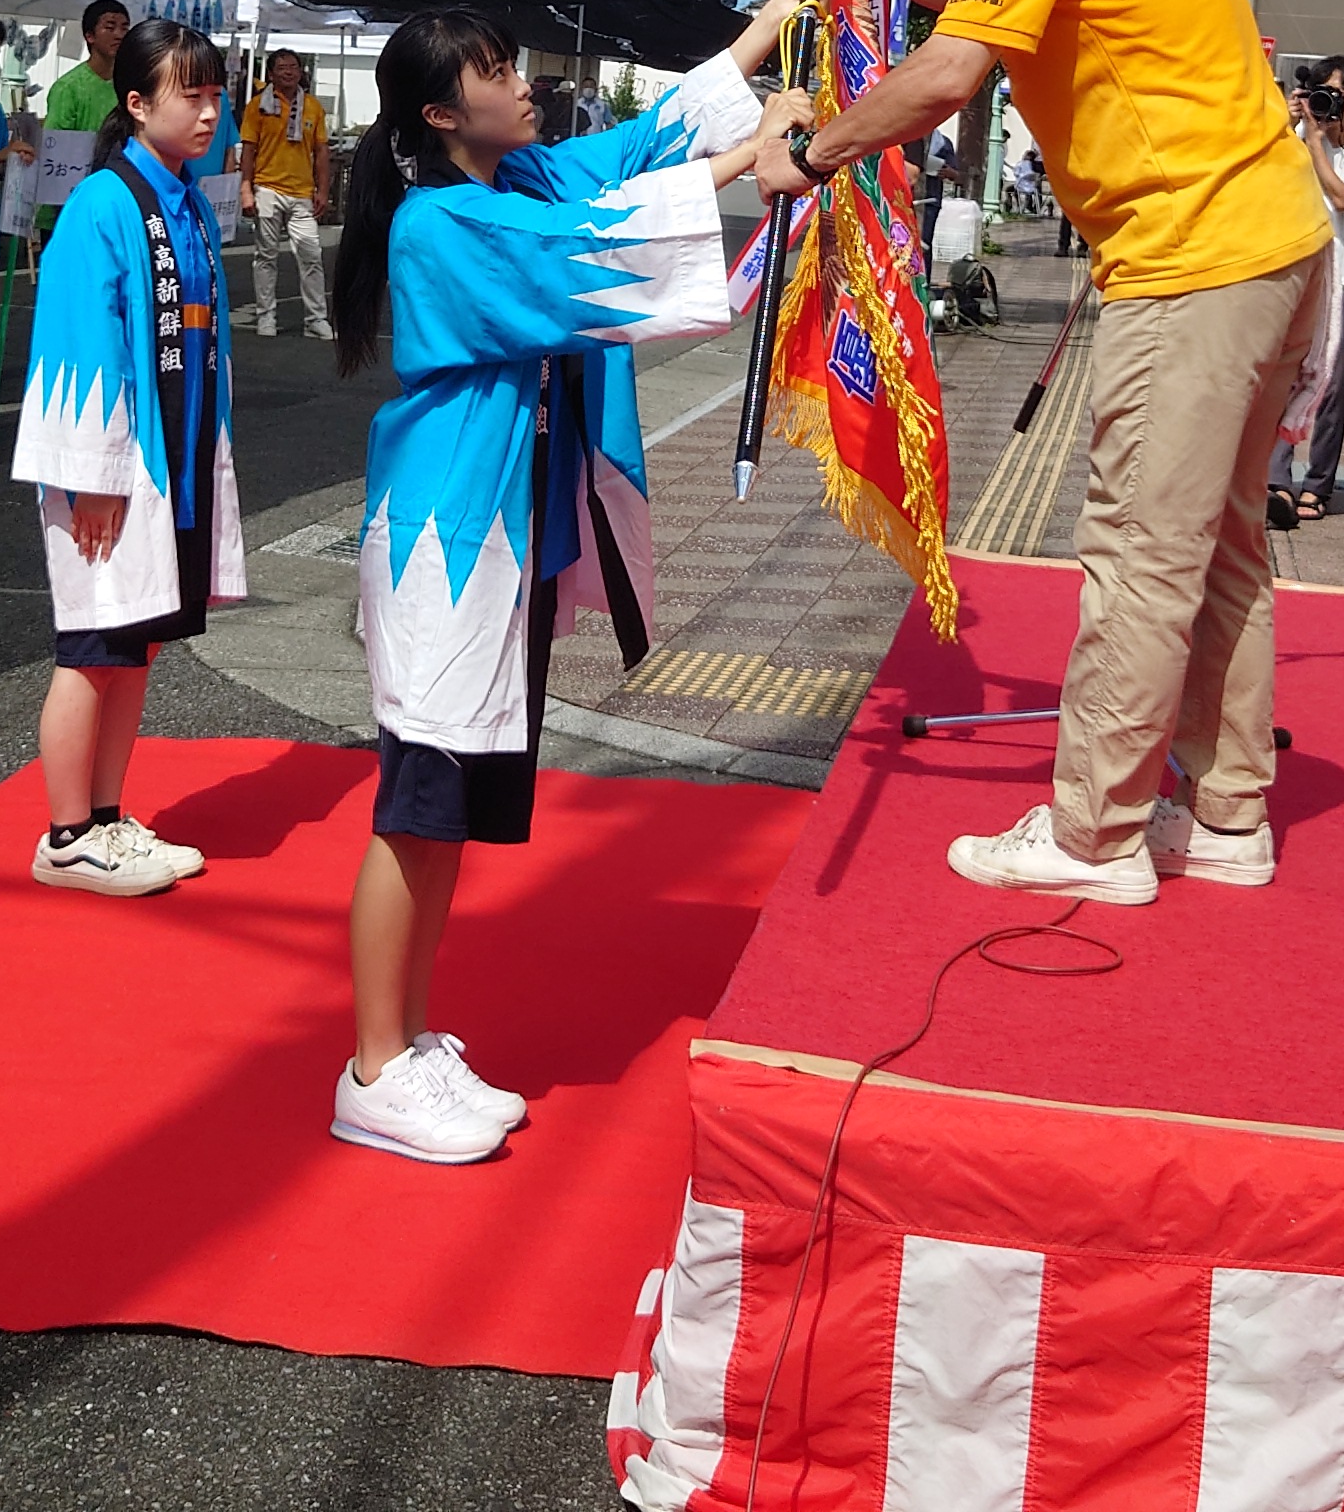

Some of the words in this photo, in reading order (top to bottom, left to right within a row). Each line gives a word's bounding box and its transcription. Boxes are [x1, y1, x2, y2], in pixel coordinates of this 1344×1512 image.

[145, 213, 184, 373] 南高新鮮組
